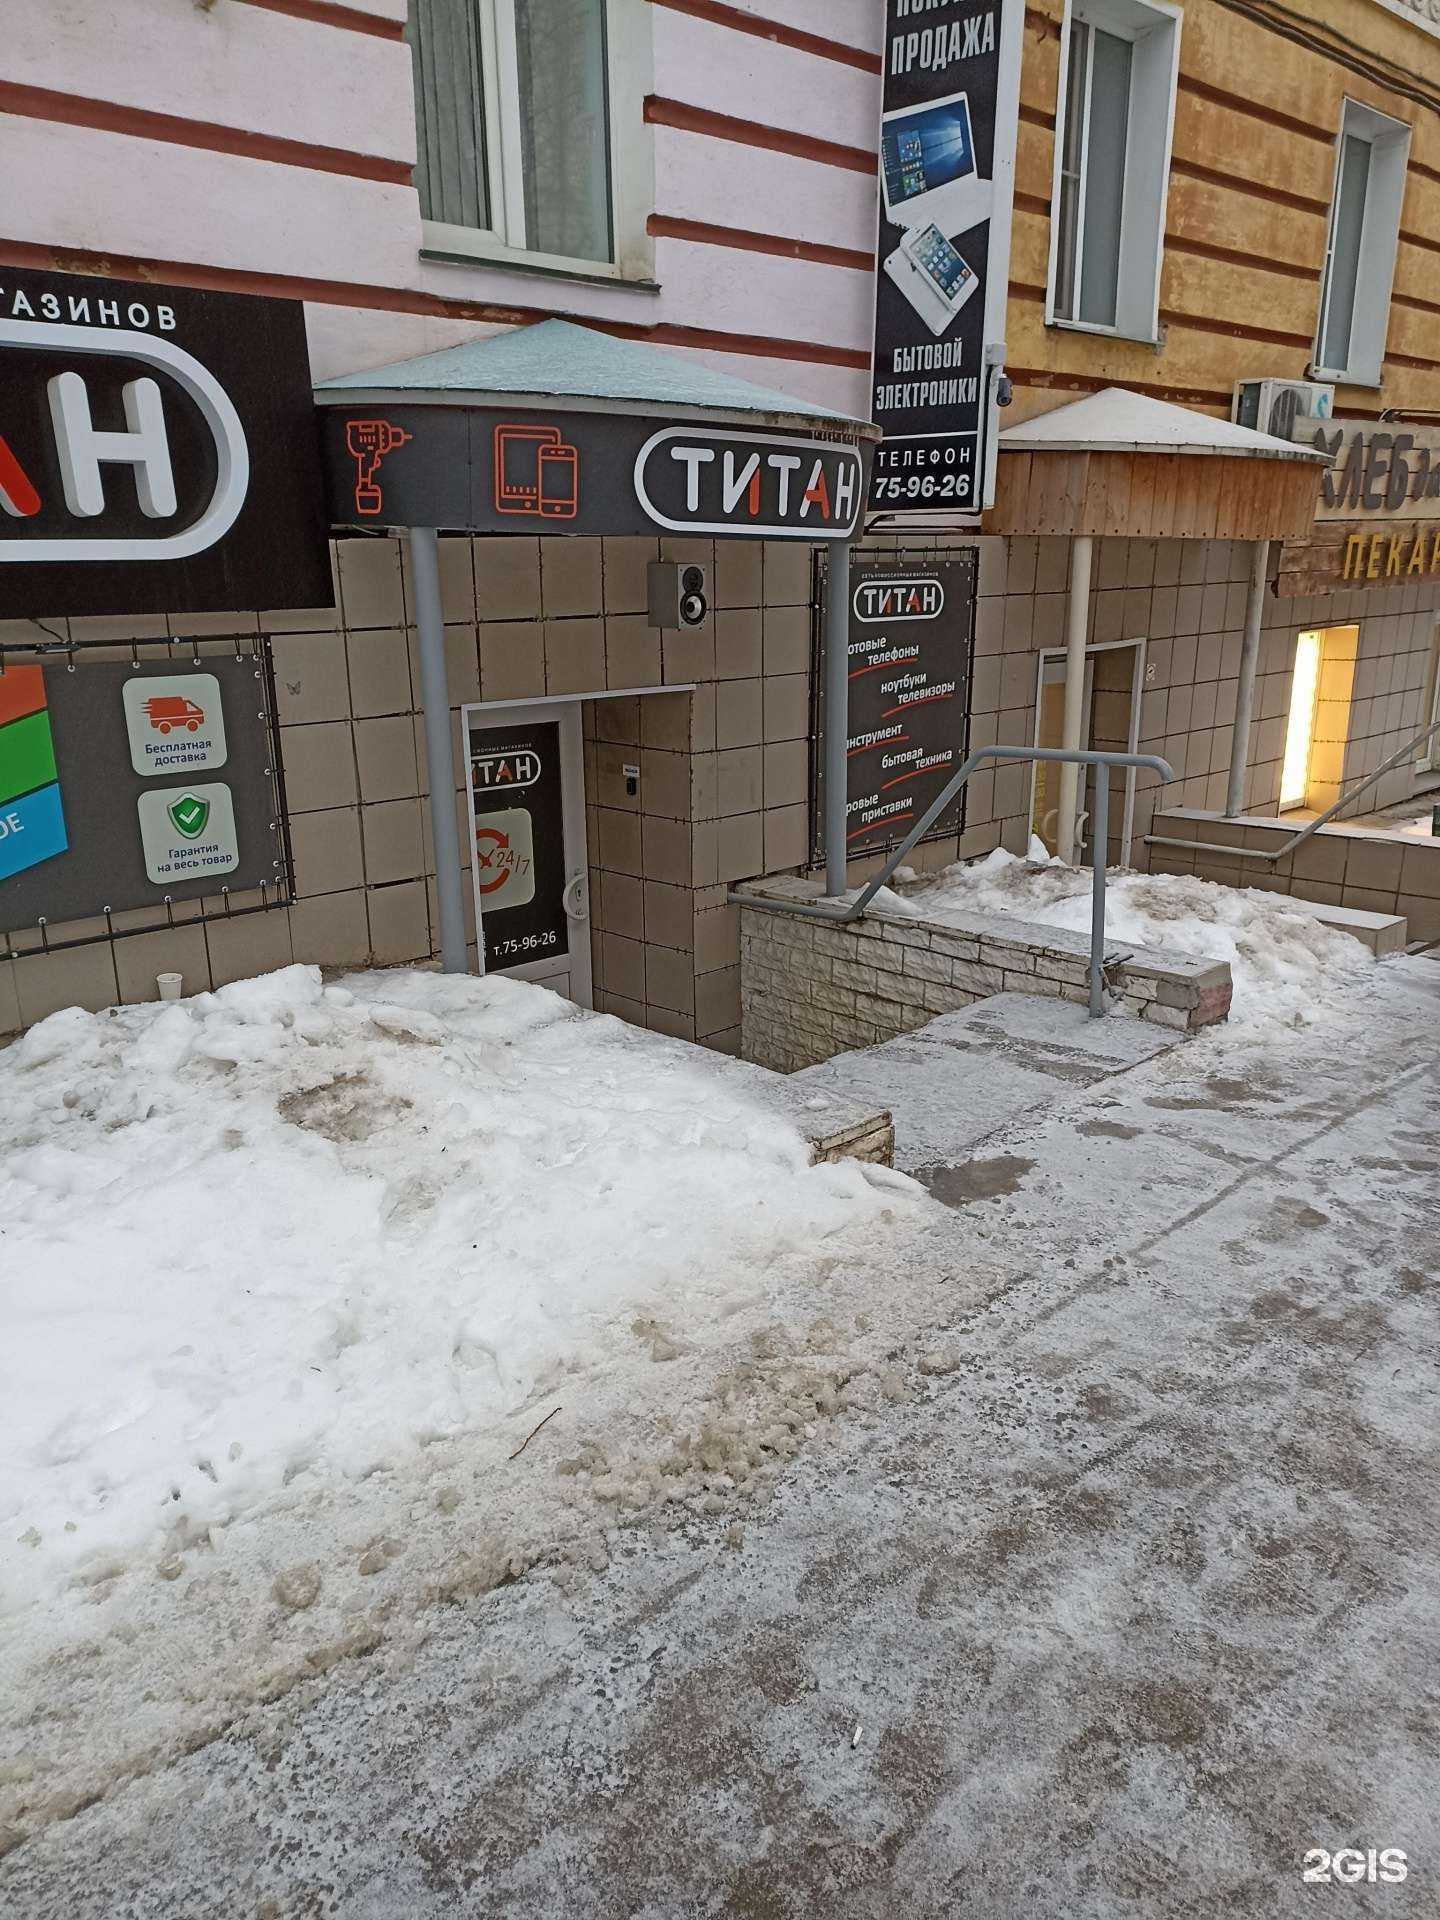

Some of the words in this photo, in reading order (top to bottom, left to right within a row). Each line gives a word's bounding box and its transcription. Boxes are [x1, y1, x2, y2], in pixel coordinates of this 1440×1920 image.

[891, 12, 995, 75] ПРОДАЖА
[0, 288, 177, 330] АЗИНОВ
[893, 337, 963, 373] БЫТОВОЙ
[876, 377, 977, 410] ЭЛЕКТРОНИКИ
[878, 447, 970, 467] ТЕЛЕФОН
[670, 446, 855, 519] ТИТАН
[875, 474, 971, 499] 75-96-26
[863, 587, 936, 615] ТИТАН
[847, 637, 887, 655] отовые
[867, 644, 919, 666] телефоны
[880, 673, 927, 693] ноутбуки
[897, 681, 956, 704] телевизоры
[145, 740, 212, 754] Бесплатная
[881, 747, 923, 769] бытовая
[154, 752, 207, 767] доставка
[471, 757, 531, 784] ТАН
[915, 750, 953, 769] техника
[845, 794, 879, 817] ровые
[861, 797, 913, 823] приставки
[168, 844, 219, 859] Гарантия
[496, 849, 530, 875] 24/7
[157, 864, 171, 873] на
[174, 859, 199, 869] весь
[202, 854, 233, 866] товар
